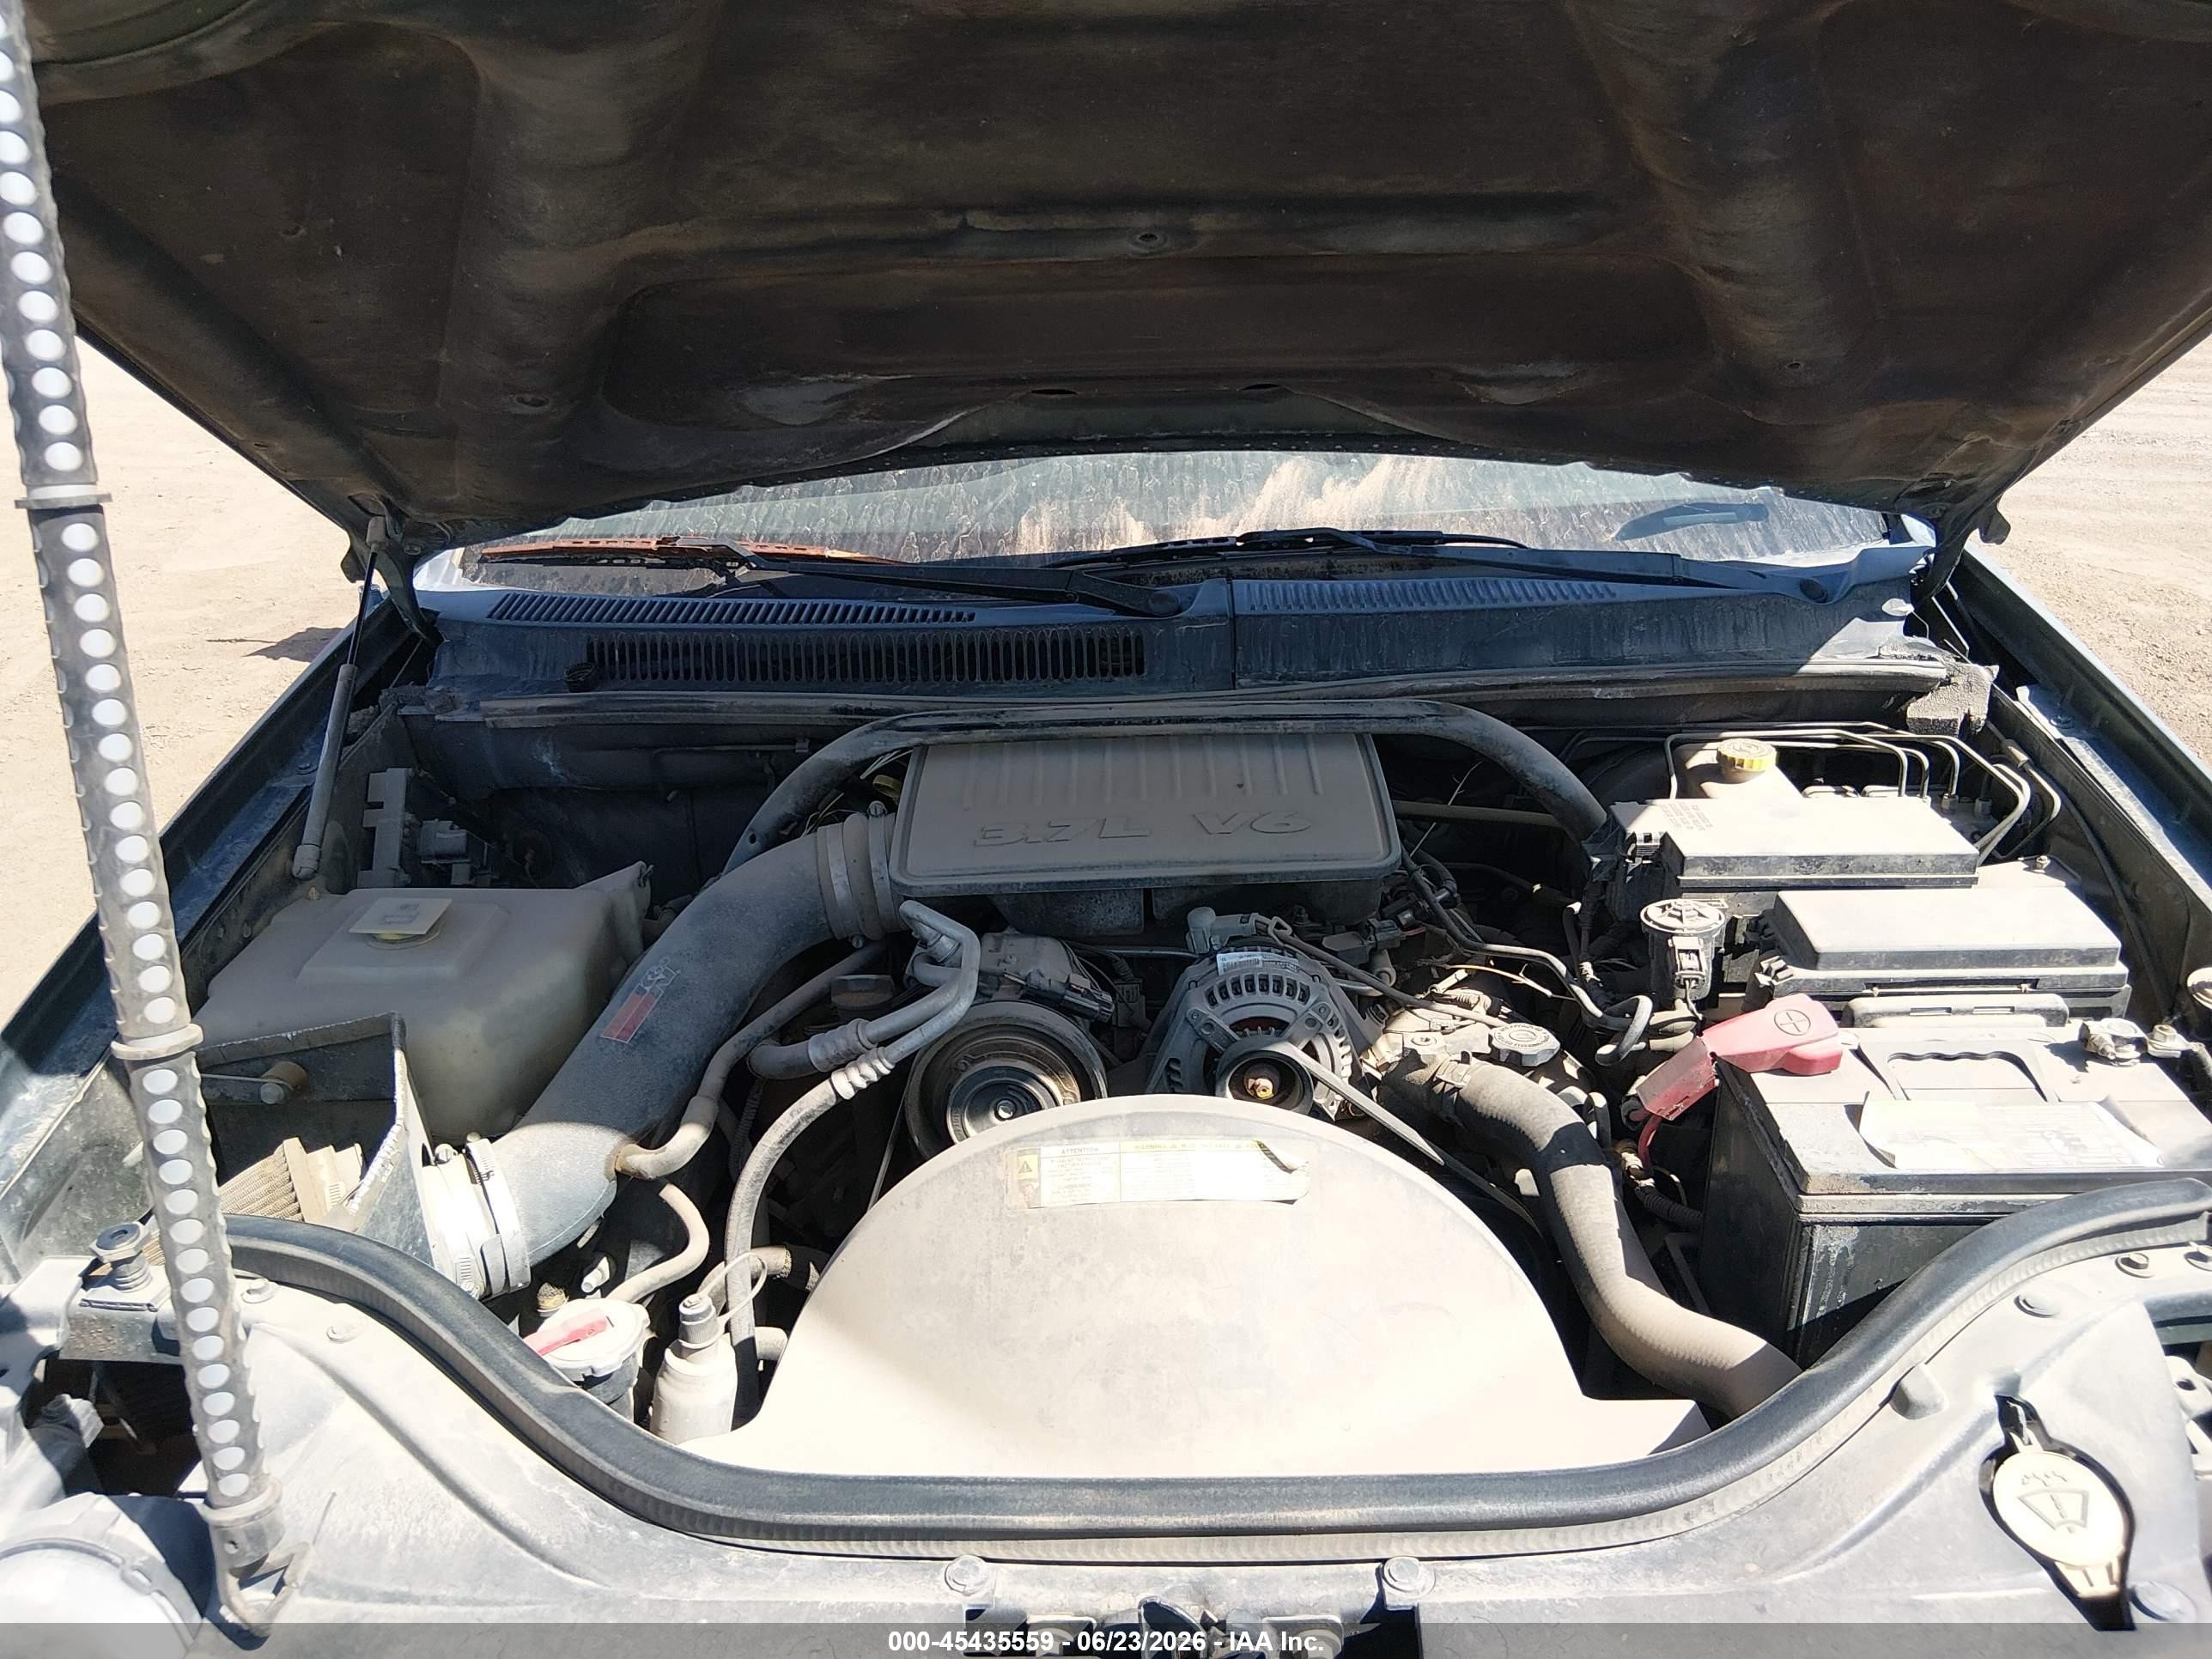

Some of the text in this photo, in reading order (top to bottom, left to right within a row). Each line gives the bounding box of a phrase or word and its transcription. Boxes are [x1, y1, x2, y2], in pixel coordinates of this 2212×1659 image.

[973, 811, 1313, 848] 3.7L V6
[1060, 1146, 1099, 1155] ATTENTION
